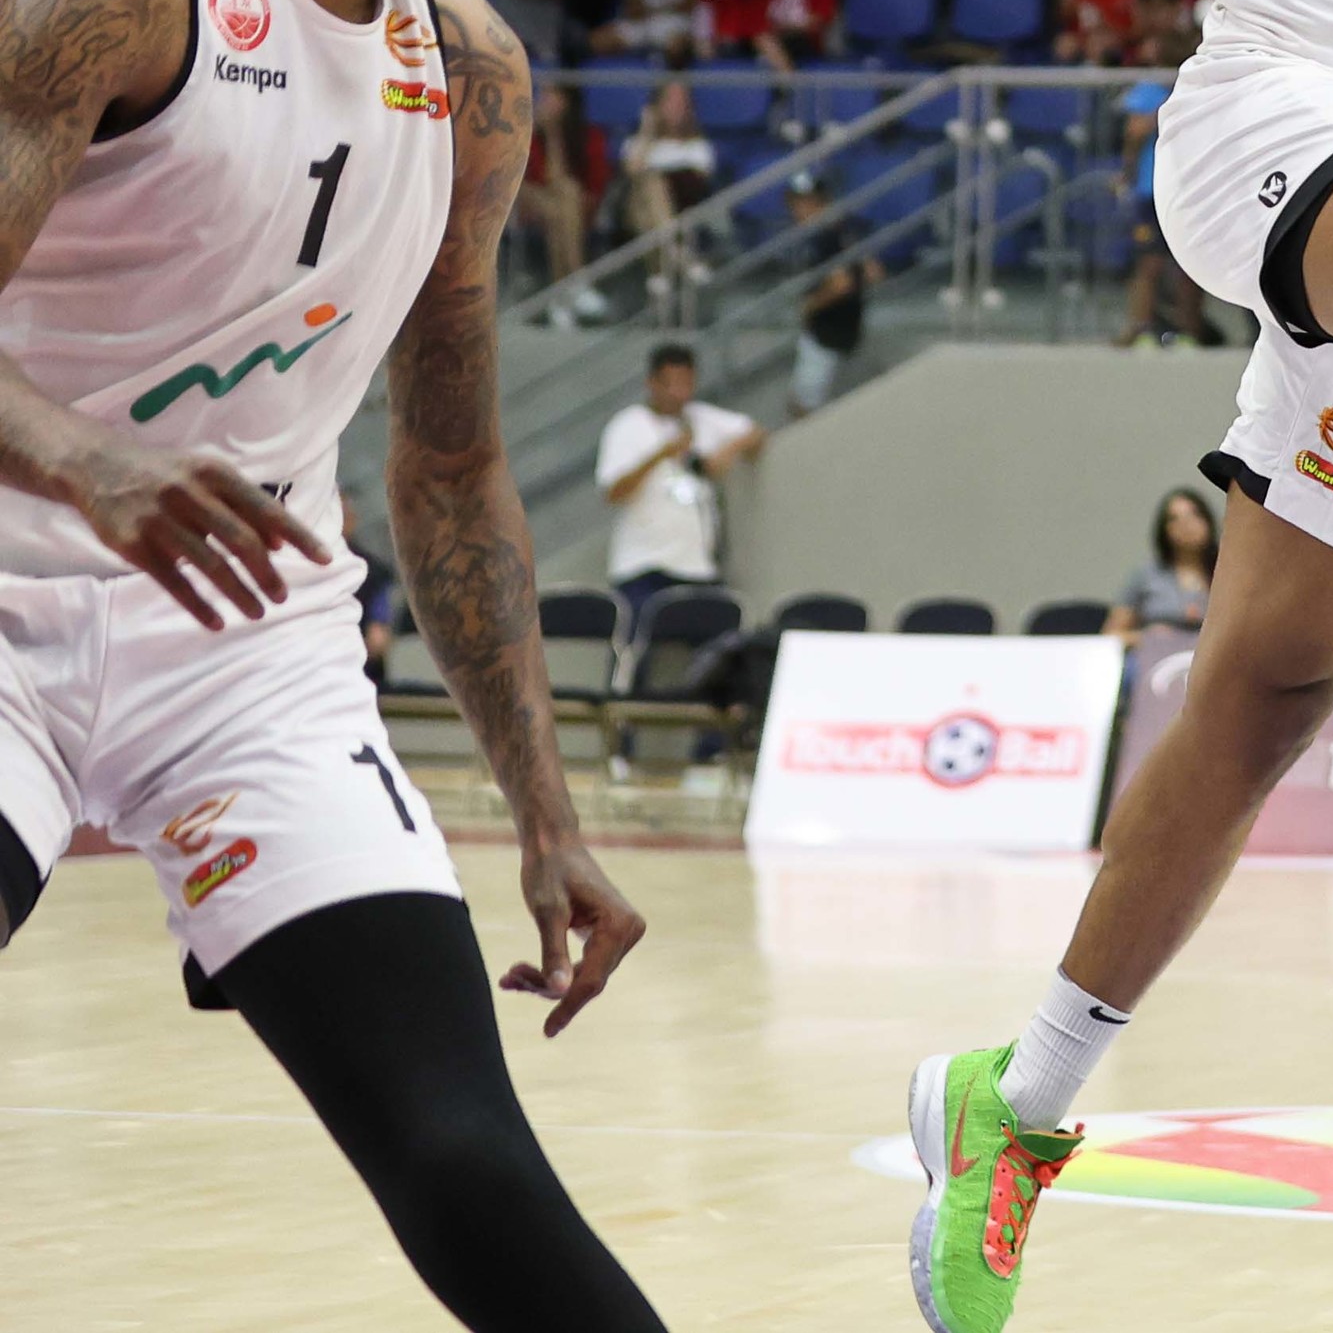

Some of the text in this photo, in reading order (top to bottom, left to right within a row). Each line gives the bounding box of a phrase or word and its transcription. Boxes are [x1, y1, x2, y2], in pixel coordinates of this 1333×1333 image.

[214, 54, 287, 93] Kempa
[297, 142, 351, 268] 1
[350, 741, 416, 834] 1
